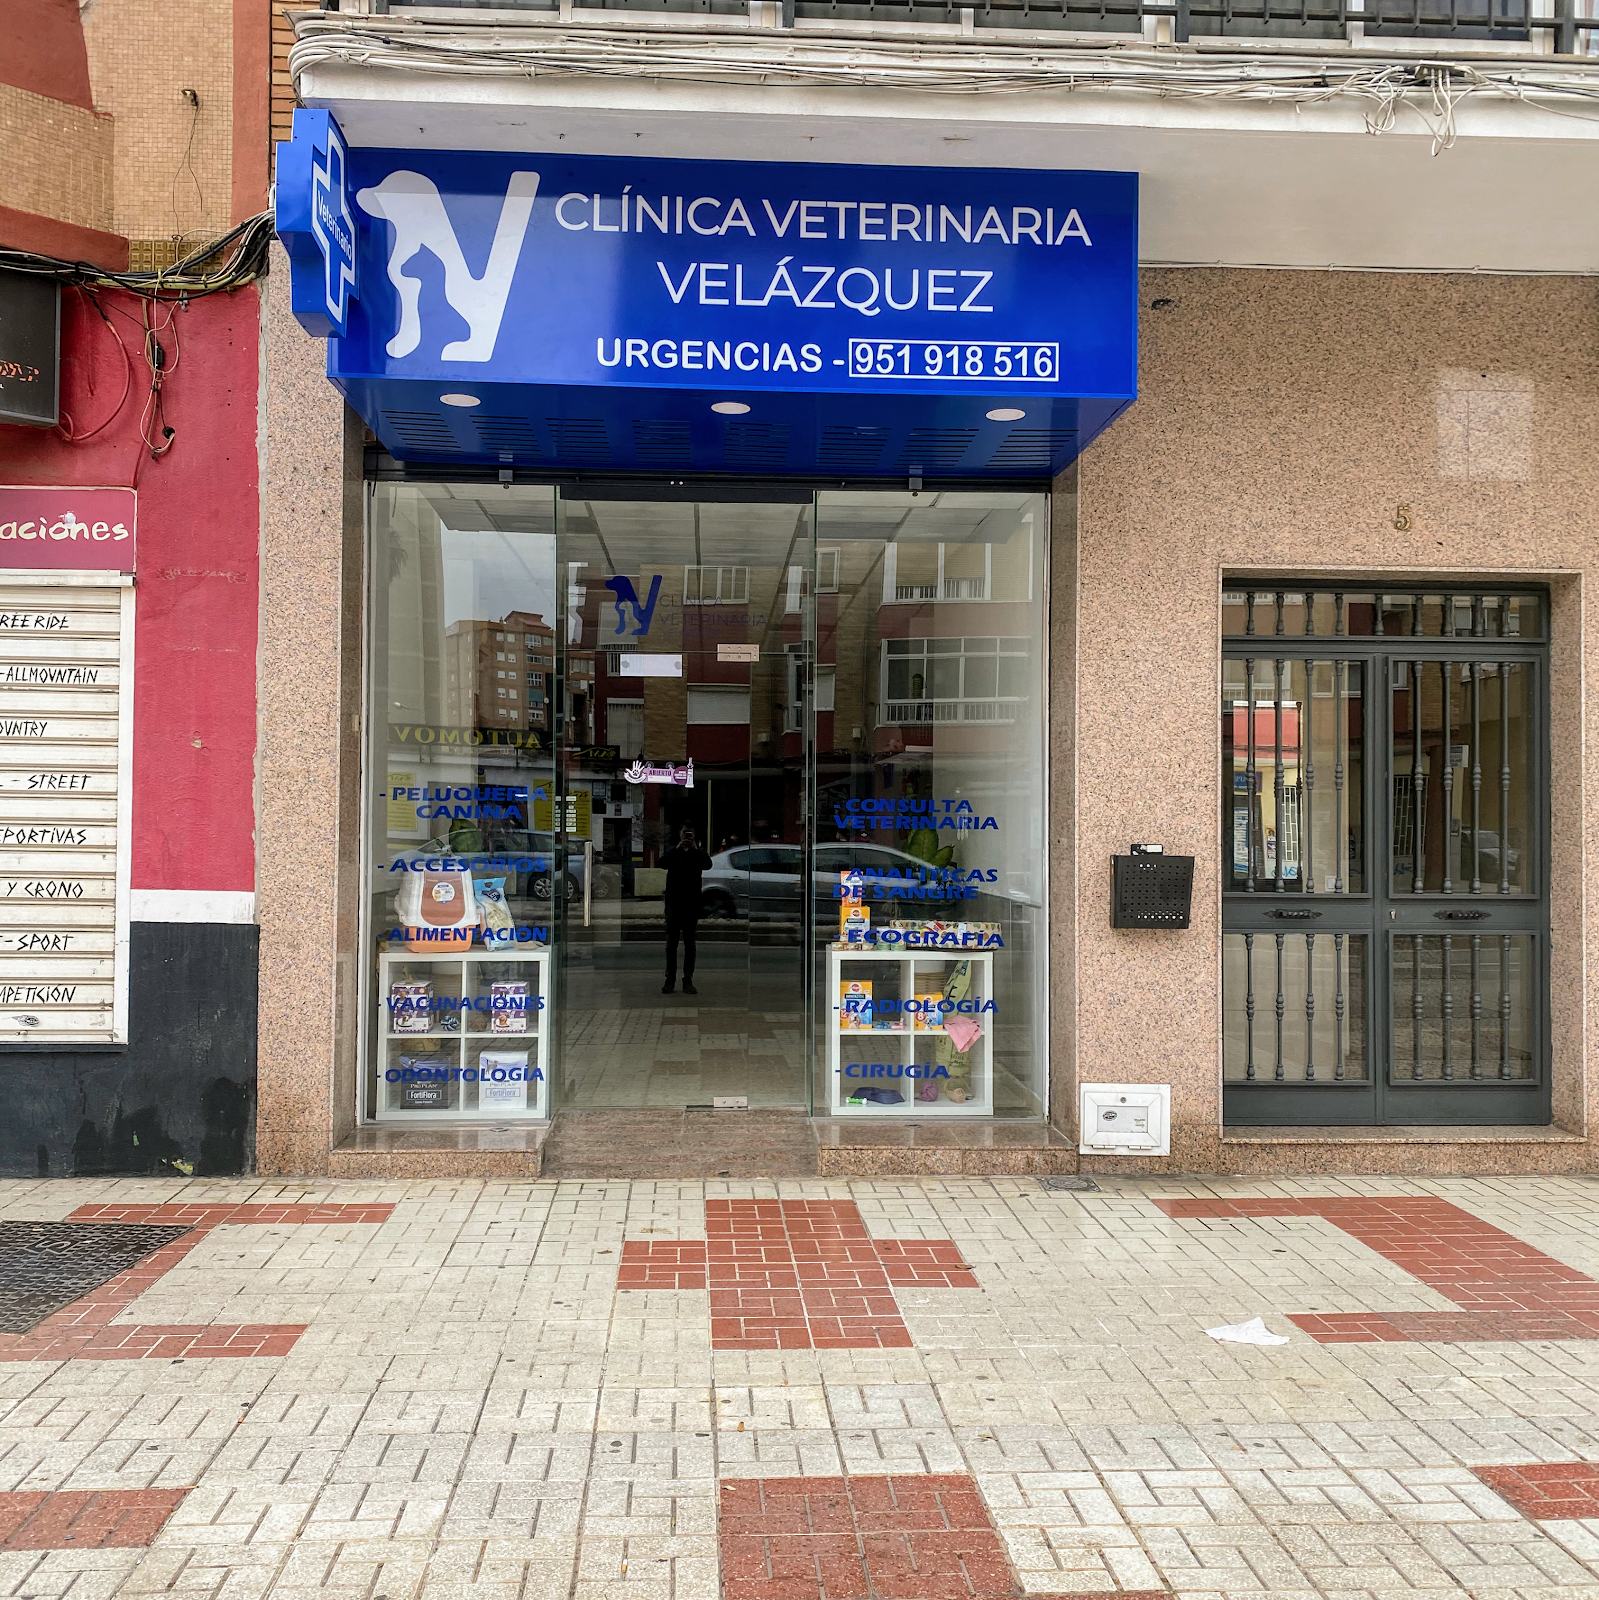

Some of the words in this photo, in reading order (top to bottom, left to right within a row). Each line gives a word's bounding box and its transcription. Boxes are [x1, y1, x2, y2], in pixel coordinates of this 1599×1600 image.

[555, 185, 755, 238] CLÍNICA
[763, 199, 1093, 246] VETERINARIA
[317, 189, 353, 262] Veterinario
[656, 256, 994, 316] VELÁZQUEZ
[597, 337, 823, 373] URGENCIAS
[855, 343, 910, 375] 951
[925, 344, 984, 376] 918
[993, 346, 1053, 378] 516
[1395, 505, 1411, 531] 5
[0, 613, 32, 629] REE
[34, 612, 69, 630] RIDE
[27, 774, 92, 790] STREET
[416, 804, 523, 820] CANINA
[845, 798, 974, 813] CONSULTA
[833, 815, 999, 830] VETERINARIA
[389, 857, 547, 873] ACCESORIOS
[6, 881, 18, 897] Y
[24, 880, 84, 899] CRONO
[833, 884, 866, 899] DE
[873, 884, 979, 900] SANGRE
[387, 924, 548, 943] ALIMENTACIÓN
[847, 929, 1005, 948] ECOGRAFÍA
[386, 996, 545, 1011] VACUNACIONES
[845, 996, 999, 1014] RADIOLOGÍA
[385, 1065, 544, 1083] ODONTOLOGÍA
[845, 1060, 950, 1079] CIRUGÍA
